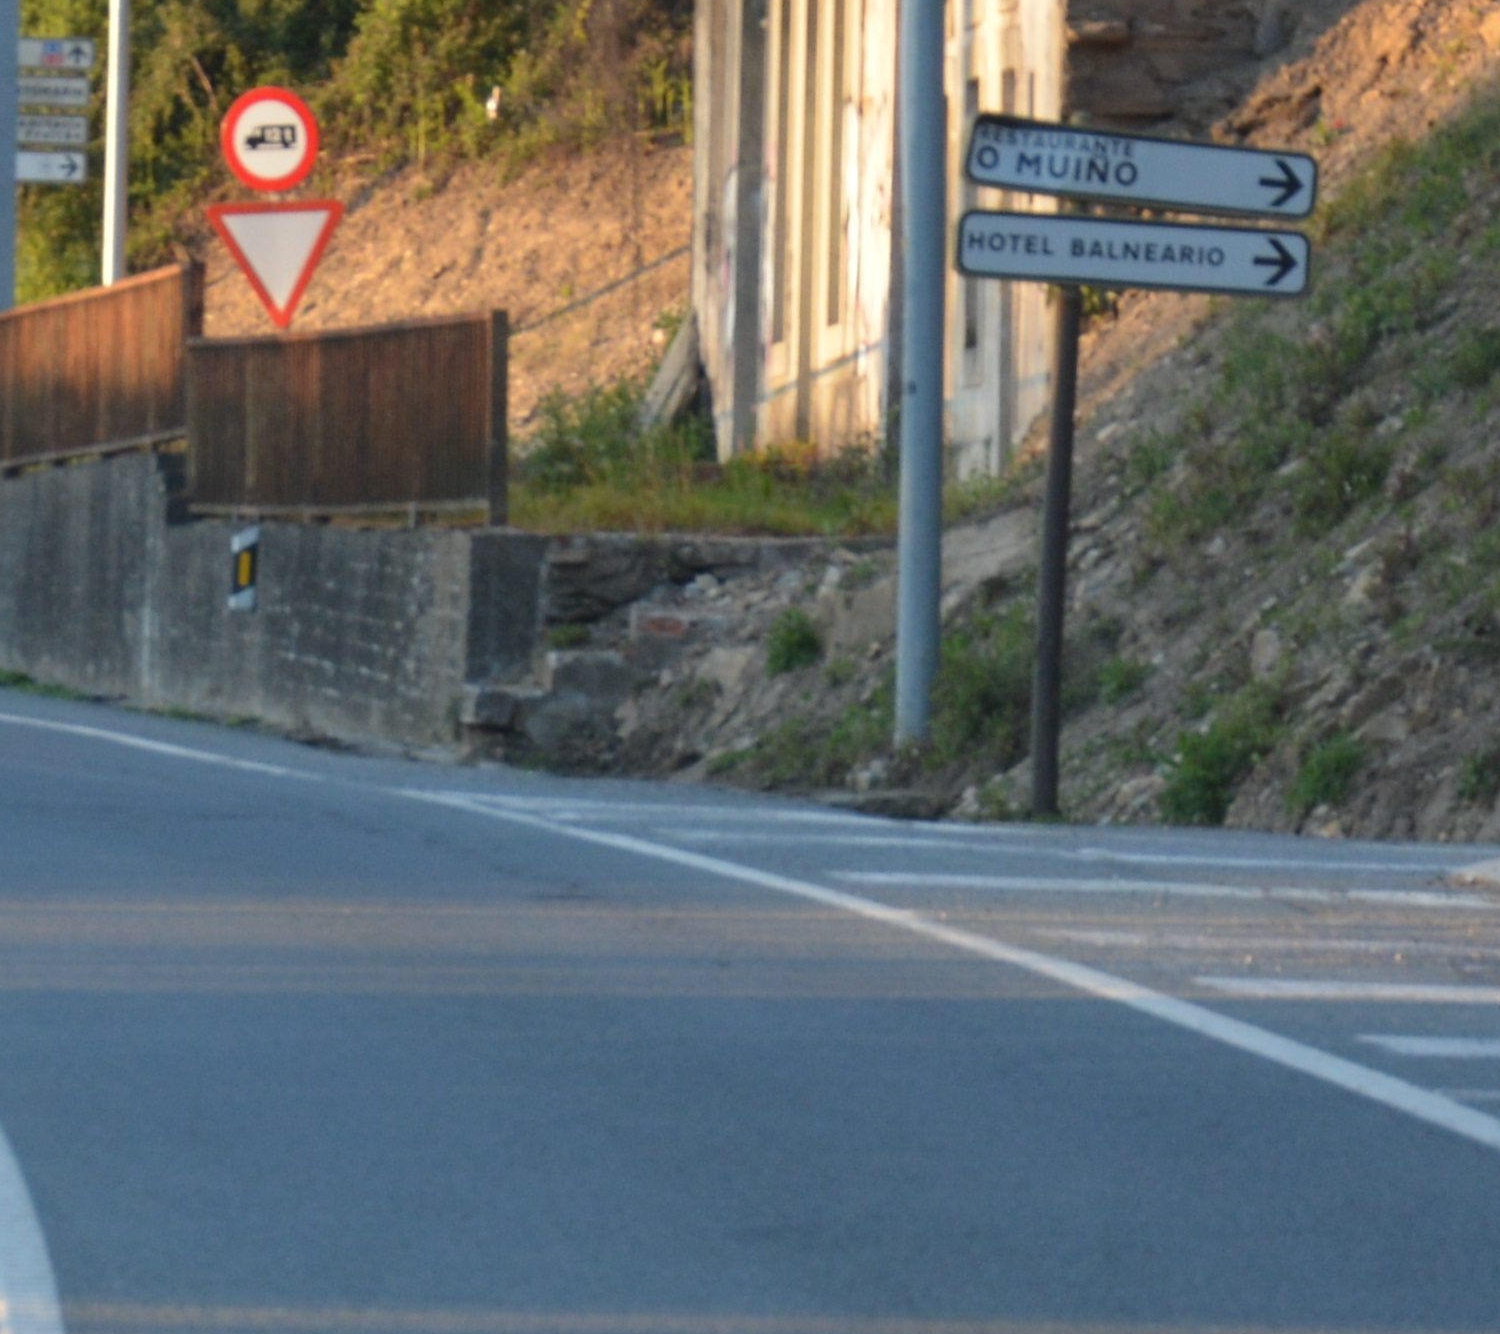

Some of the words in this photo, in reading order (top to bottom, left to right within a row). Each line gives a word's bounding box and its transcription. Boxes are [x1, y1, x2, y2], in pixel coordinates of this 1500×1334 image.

[978, 145, 1000, 170] O
[968, 231, 1053, 256] HOTEL
[1071, 238, 1226, 268] BALNEARIO
